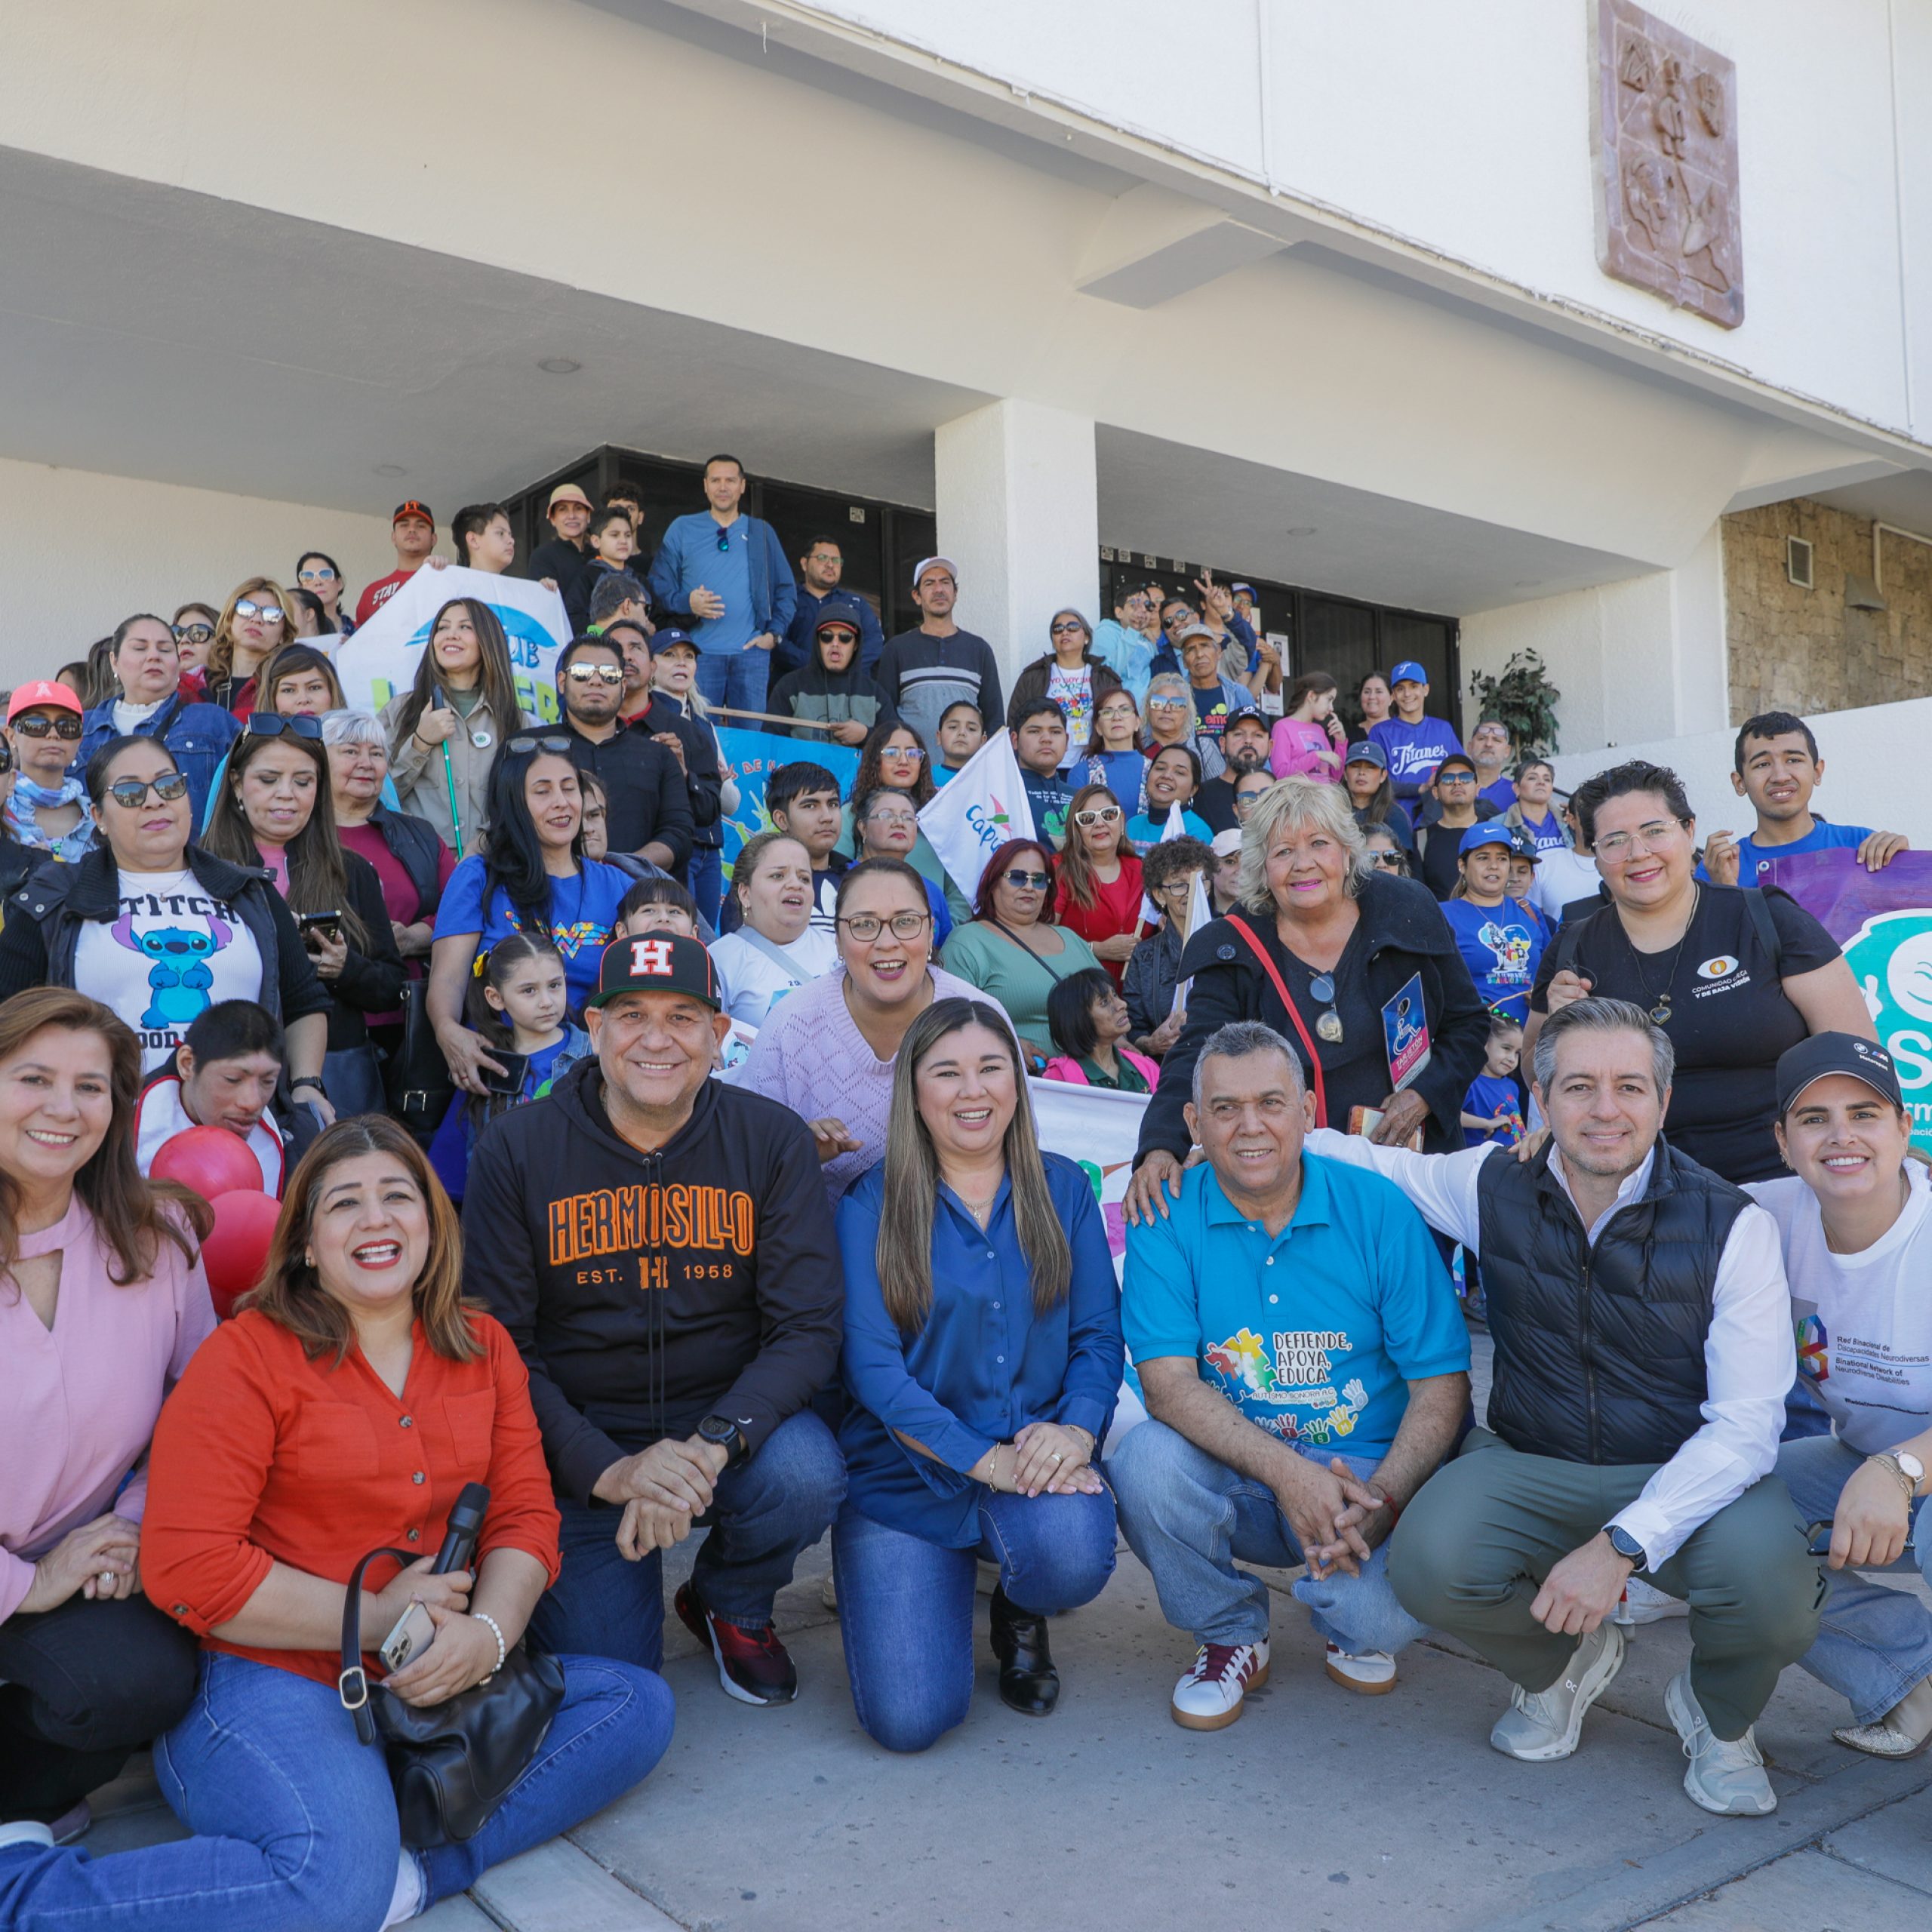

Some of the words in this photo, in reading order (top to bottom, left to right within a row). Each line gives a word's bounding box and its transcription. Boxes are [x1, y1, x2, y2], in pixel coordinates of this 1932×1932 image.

[373, 580, 401, 606] STAY
[507, 633, 540, 669] UB
[1398, 663, 1411, 675] T
[35, 681, 53, 697] A
[742, 758, 762, 774] DE
[1392, 742, 1448, 774] Titanes
[119, 894, 239, 923] TITCH
[629, 939, 674, 977] H
[1692, 979, 1732, 993] COMUNIDAD
[1712, 985, 1730, 994] BAJA
[549, 1183, 753, 1266] HERMOSILLO
[577, 1269, 623, 1284] EST.
[683, 1264, 734, 1279] 1958
[1275, 1333, 1352, 1350] DEFIENDE,
[1278, 1350, 1331, 1367] APOYA,
[1881, 1352, 1929, 1362] Neurodiversas
[1836, 1357, 1869, 1369] Binational
[1869, 1364, 1893, 1375] Network
[1289, 1390, 1320, 1398] SONORA
